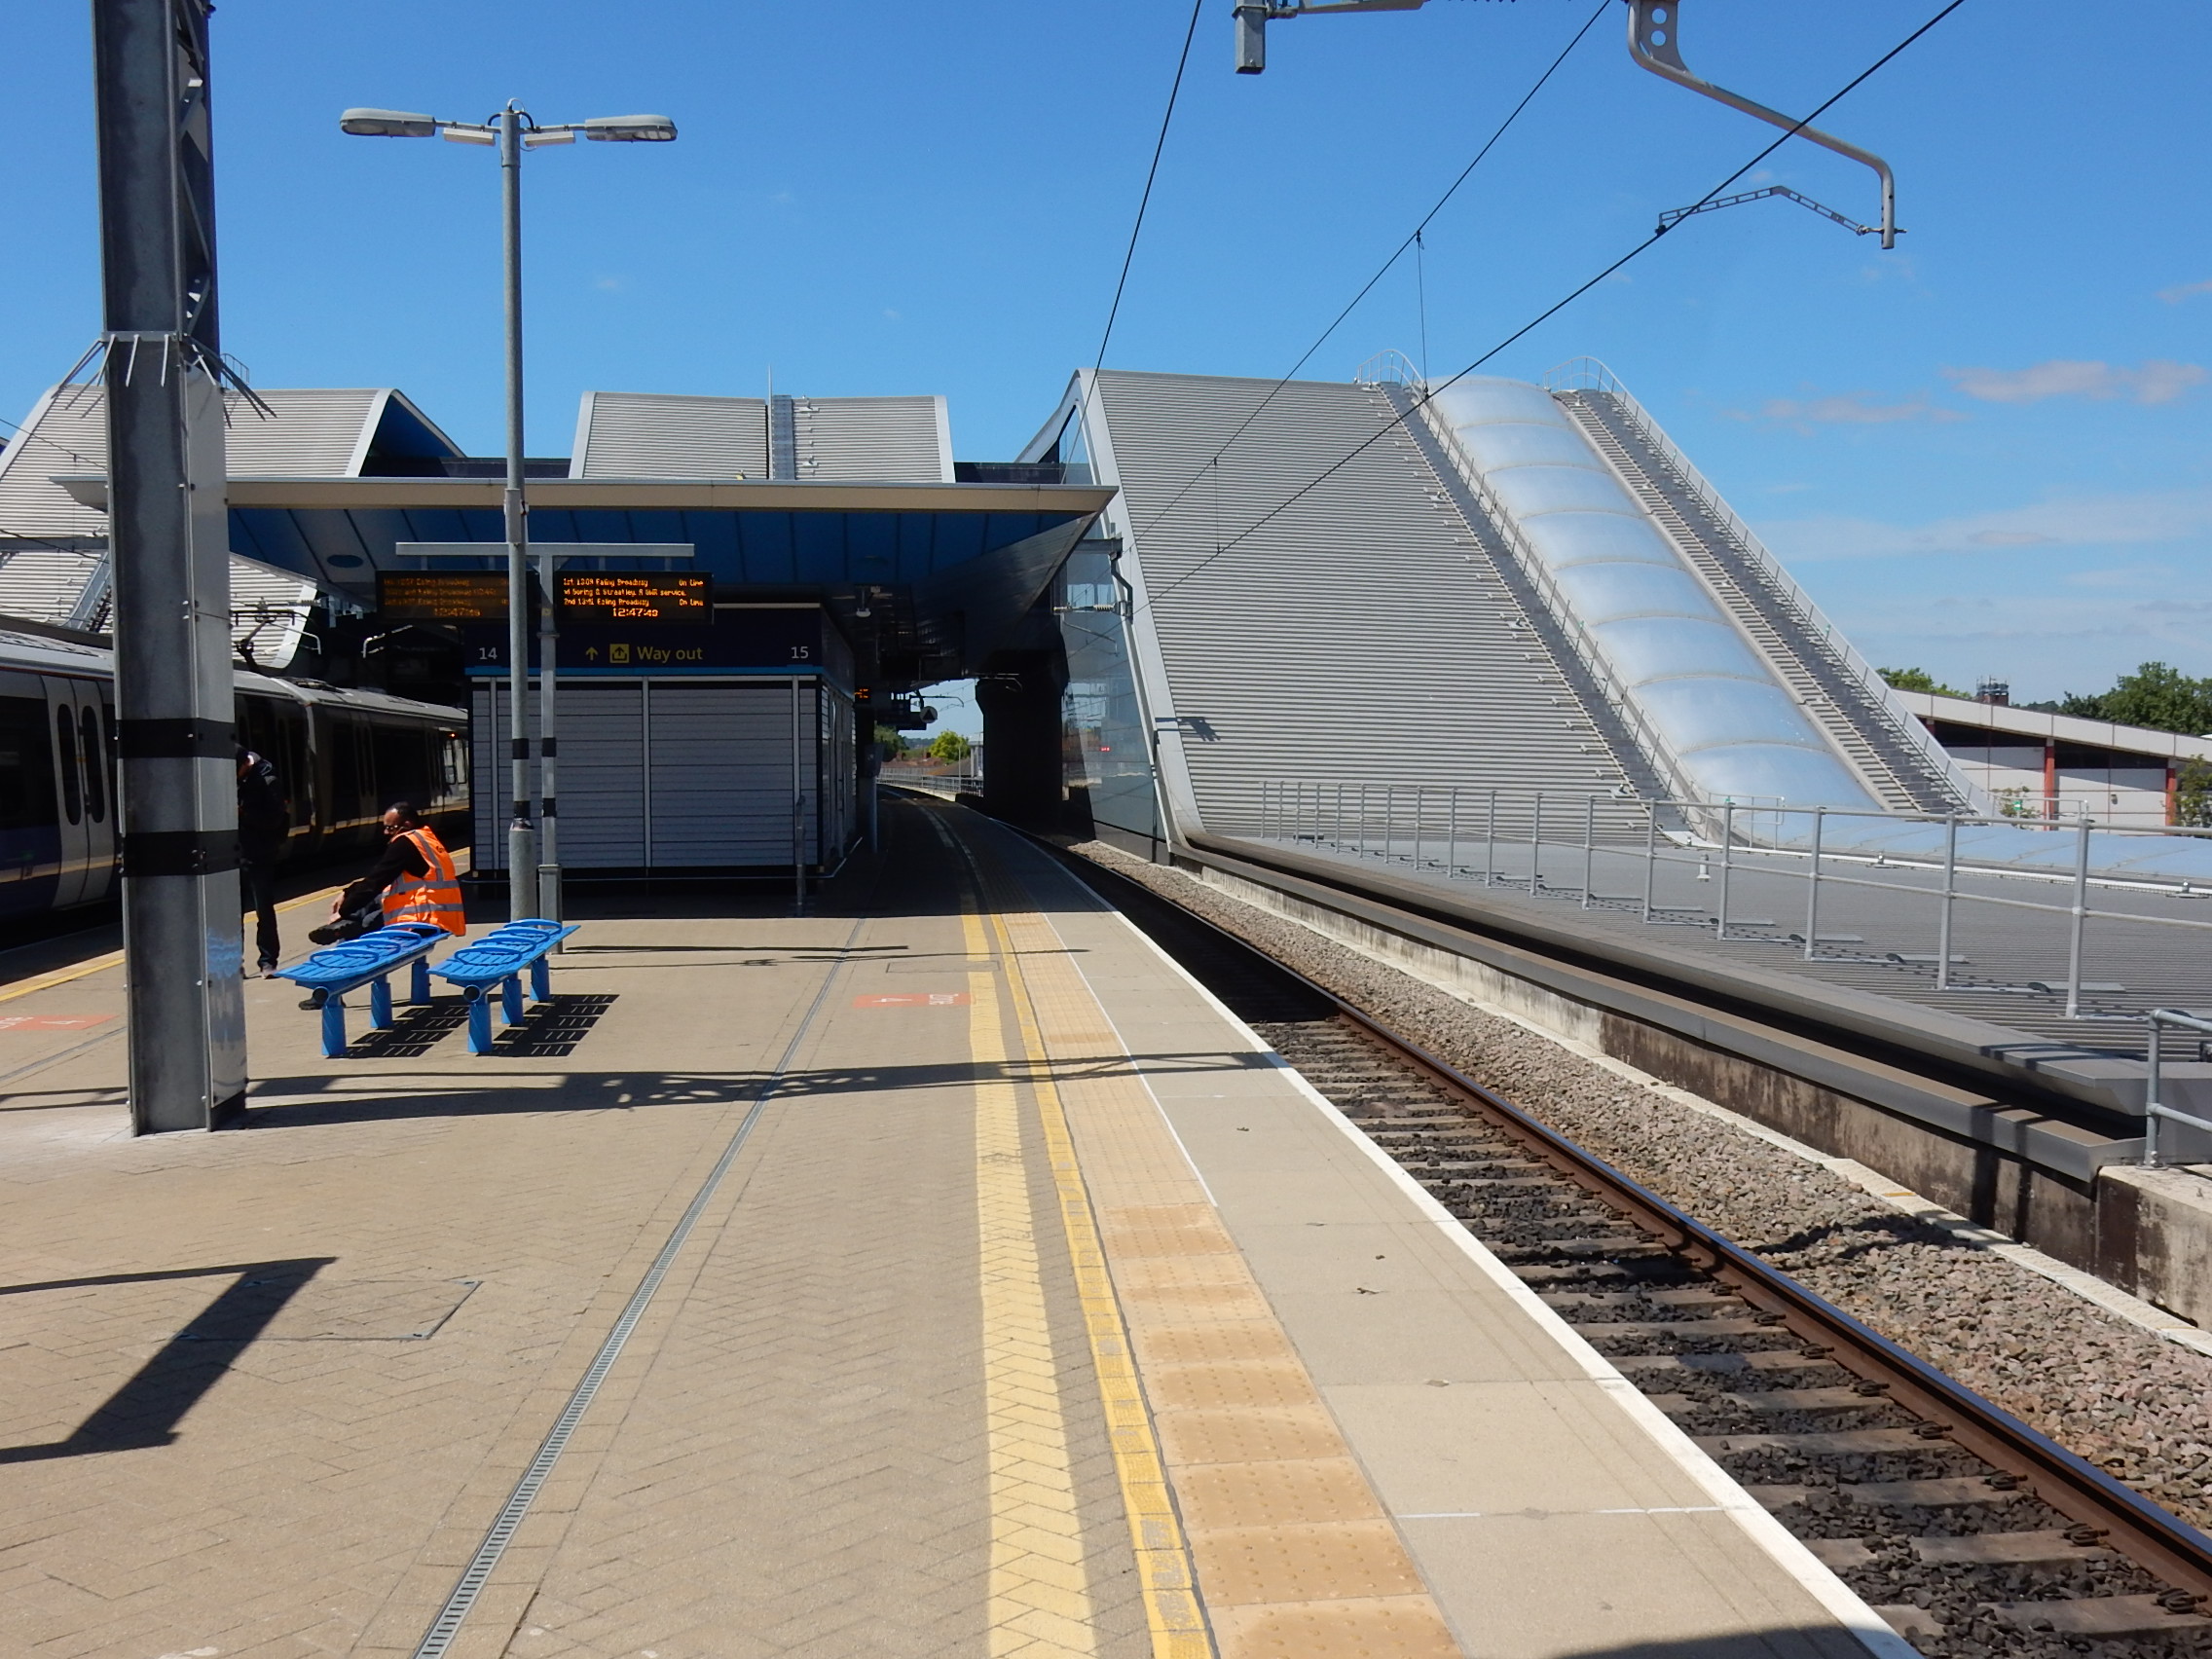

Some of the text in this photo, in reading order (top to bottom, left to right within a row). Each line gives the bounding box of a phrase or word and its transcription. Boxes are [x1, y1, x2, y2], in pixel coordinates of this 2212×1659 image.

[479, 647, 498, 660] 14
[637, 646, 703, 664] Way out
[791, 646, 809, 659] 15
